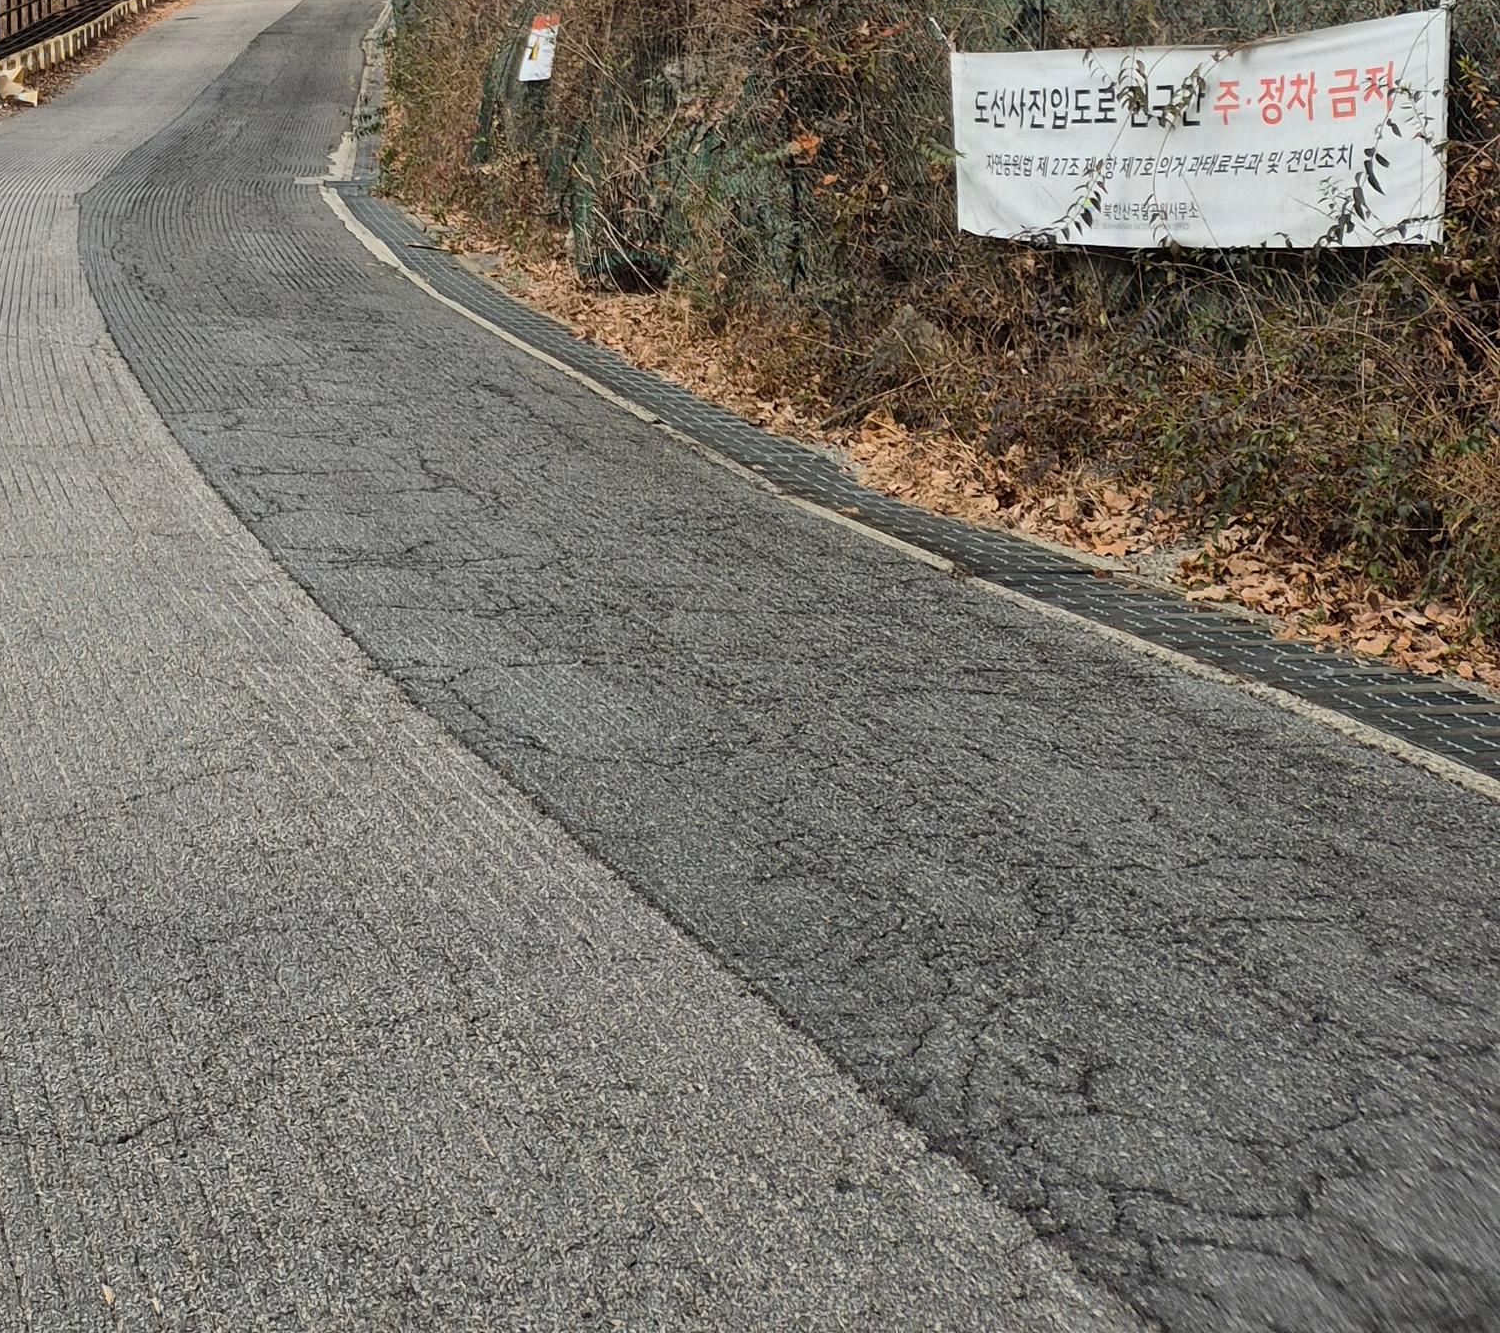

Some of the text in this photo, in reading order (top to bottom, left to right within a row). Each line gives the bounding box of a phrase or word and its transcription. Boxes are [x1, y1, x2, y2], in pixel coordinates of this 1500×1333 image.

[974, 84, 1117, 129] 도선사진입도로
[1328, 61, 1394, 119] 금지
[986, 152, 1034, 177] 자연공원법
[1037, 155, 1050, 178] 제
[1051, 157, 1080, 177] 27조
[1083, 154, 1118, 180] 제항
[1187, 152, 1264, 177] 과태료부과
[1266, 150, 1284, 175] 및
[1286, 144, 1354, 173] 견인조치
